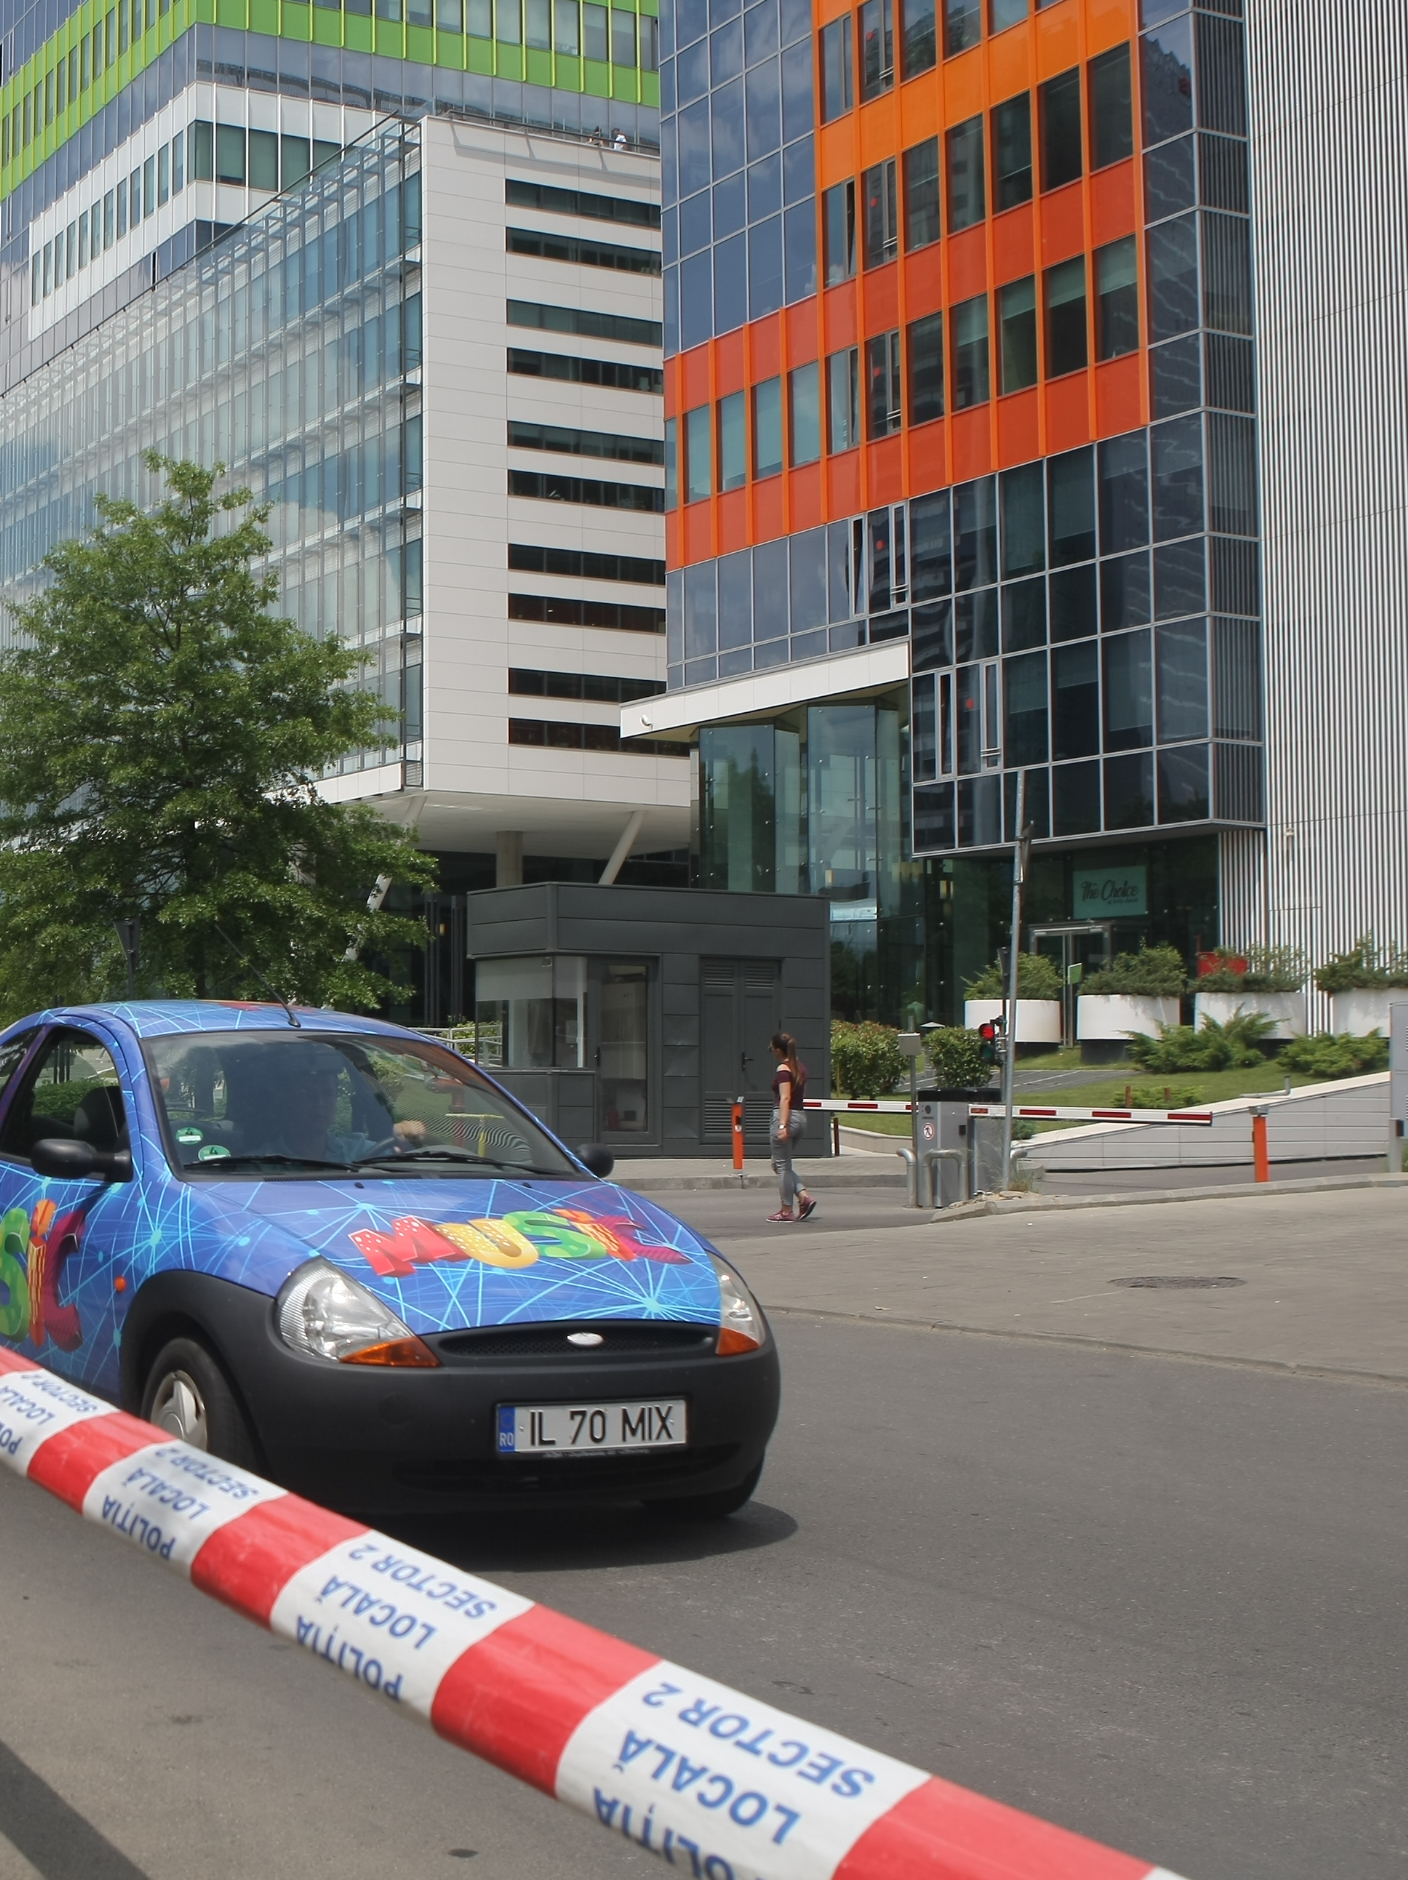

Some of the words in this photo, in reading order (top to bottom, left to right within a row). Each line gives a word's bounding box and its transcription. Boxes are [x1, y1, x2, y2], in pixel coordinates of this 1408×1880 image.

[1081, 881, 1099, 902] The
[1101, 879, 1139, 900] Choice
[499, 1432, 514, 1446] RO
[529, 1409, 556, 1446] IL
[569, 1408, 606, 1444] 70
[621, 1404, 673, 1442] MIX
[122, 1467, 211, 1520] LOCALĂ
[170, 1455, 259, 1499] SECTOR
[102, 1494, 176, 1560] POLIȚIA
[349, 1543, 380, 1561] 2
[315, 1575, 437, 1650] LOCALĂ
[371, 1555, 497, 1619] SECTOR
[297, 1615, 403, 1703] POLIȚIA
[642, 1682, 682, 1707] 2
[678, 1697, 876, 1798] SECTOR
[613, 1729, 801, 1845] LOCALĂ
[594, 1786, 761, 1880] OLIȚIA
